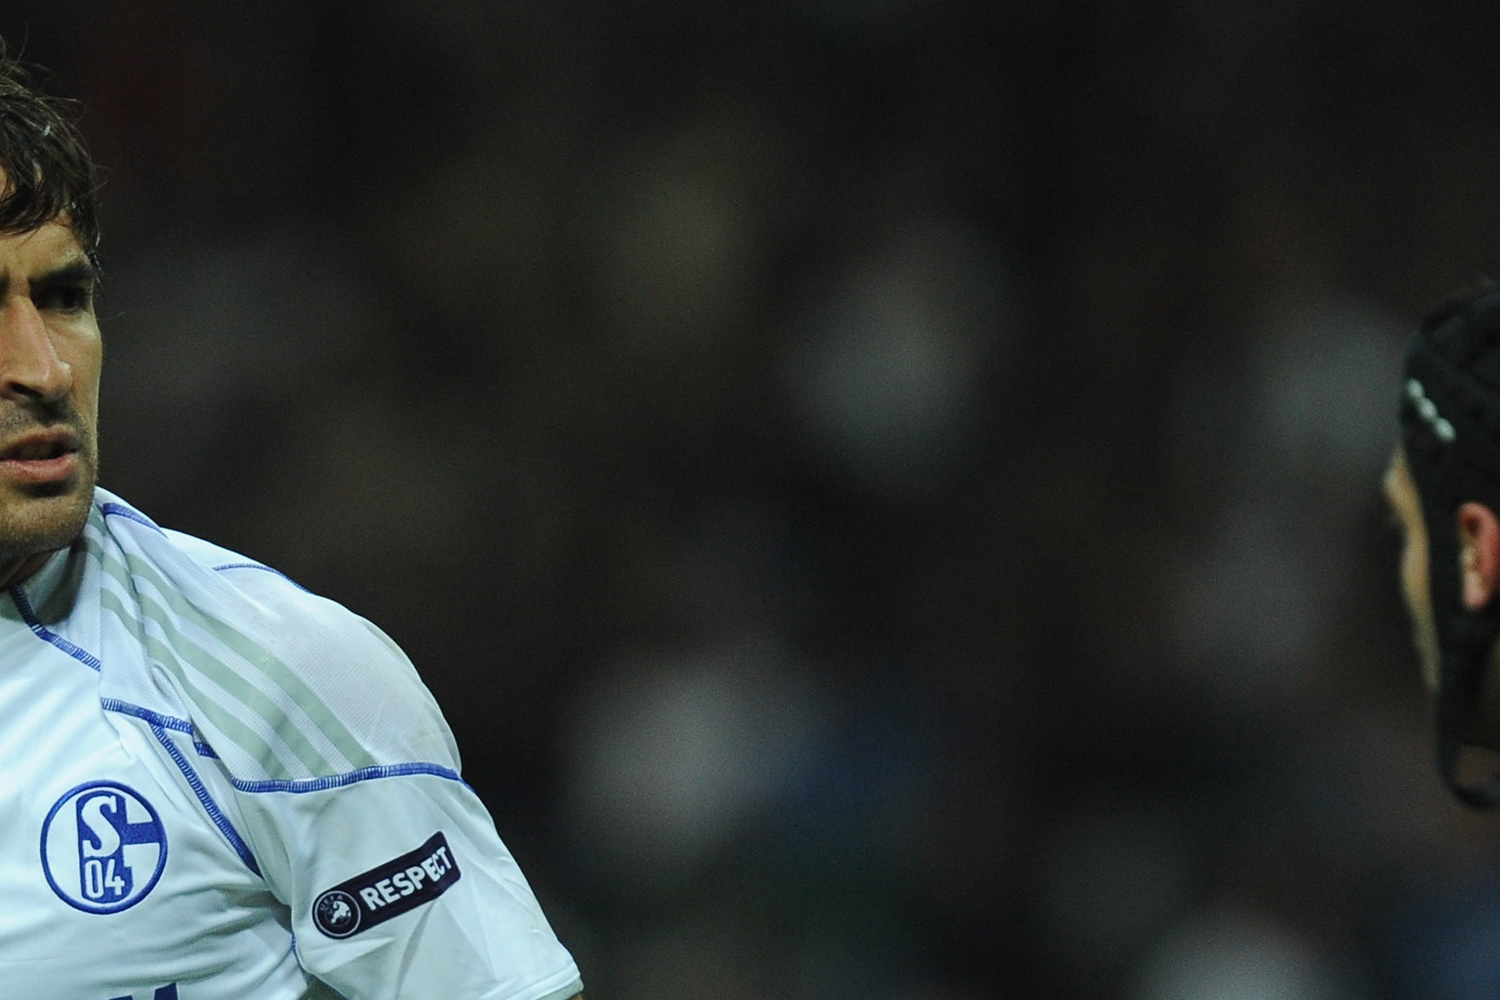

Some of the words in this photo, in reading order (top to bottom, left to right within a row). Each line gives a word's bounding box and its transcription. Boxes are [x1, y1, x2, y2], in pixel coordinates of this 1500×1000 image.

[80, 795, 121, 858] S
[84, 858, 125, 898] 04
[359, 846, 452, 911] RESPECT
